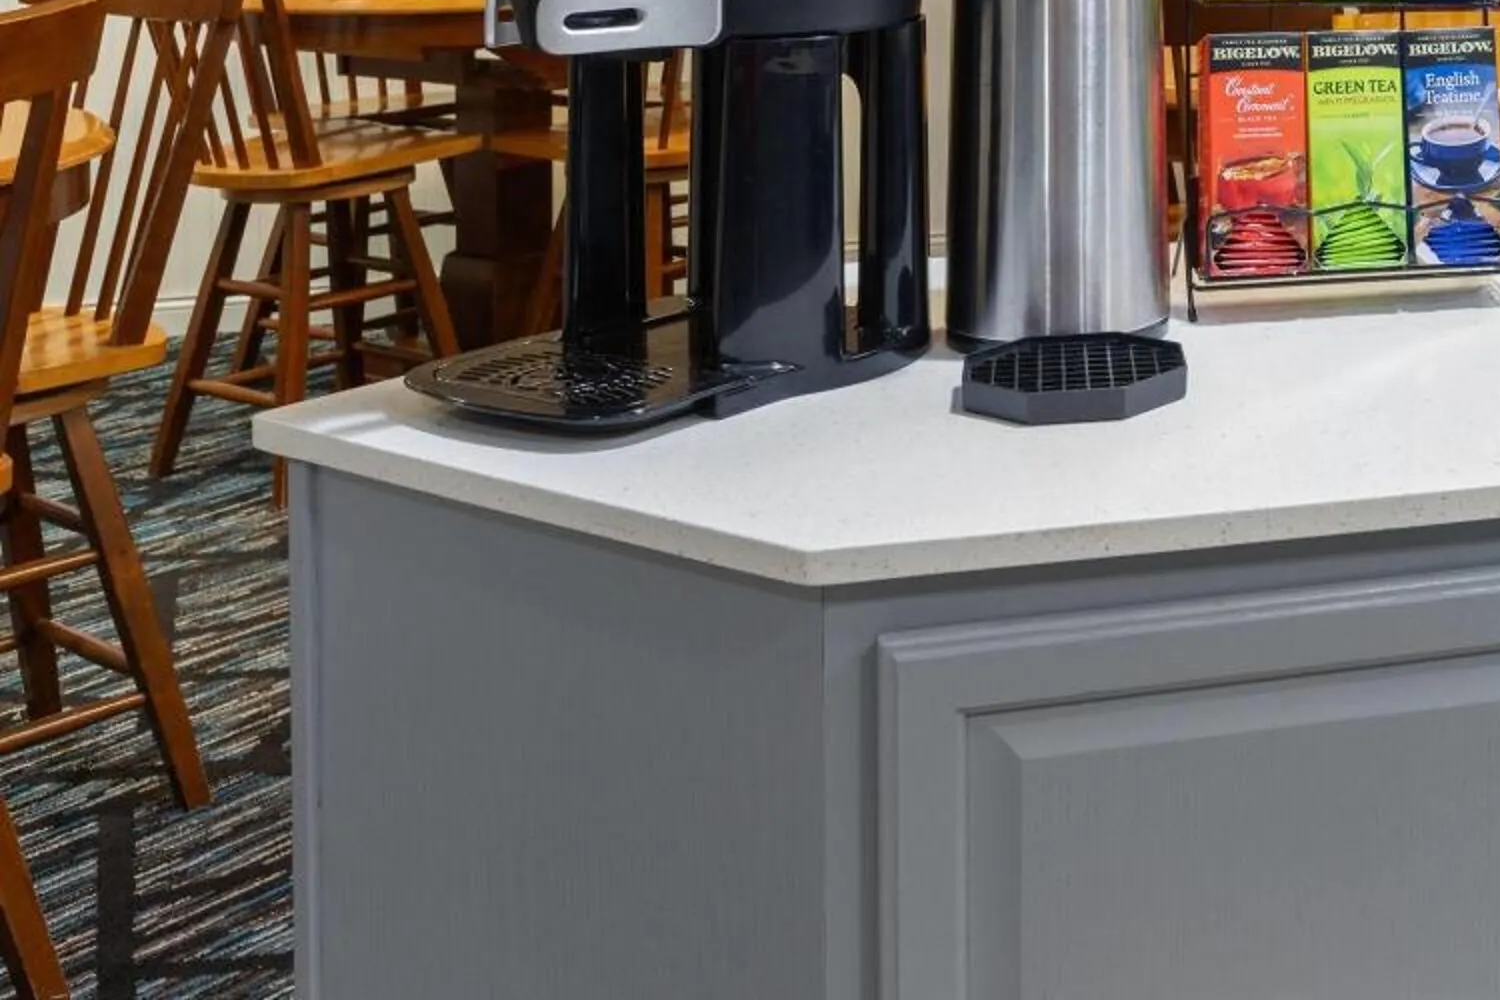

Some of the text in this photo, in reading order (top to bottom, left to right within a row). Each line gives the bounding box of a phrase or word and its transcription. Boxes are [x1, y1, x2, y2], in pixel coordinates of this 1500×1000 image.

[1313, 79, 1397, 96] GREEN TEA
[1425, 71, 1479, 91] English
[1425, 89, 1481, 105] Teatime
